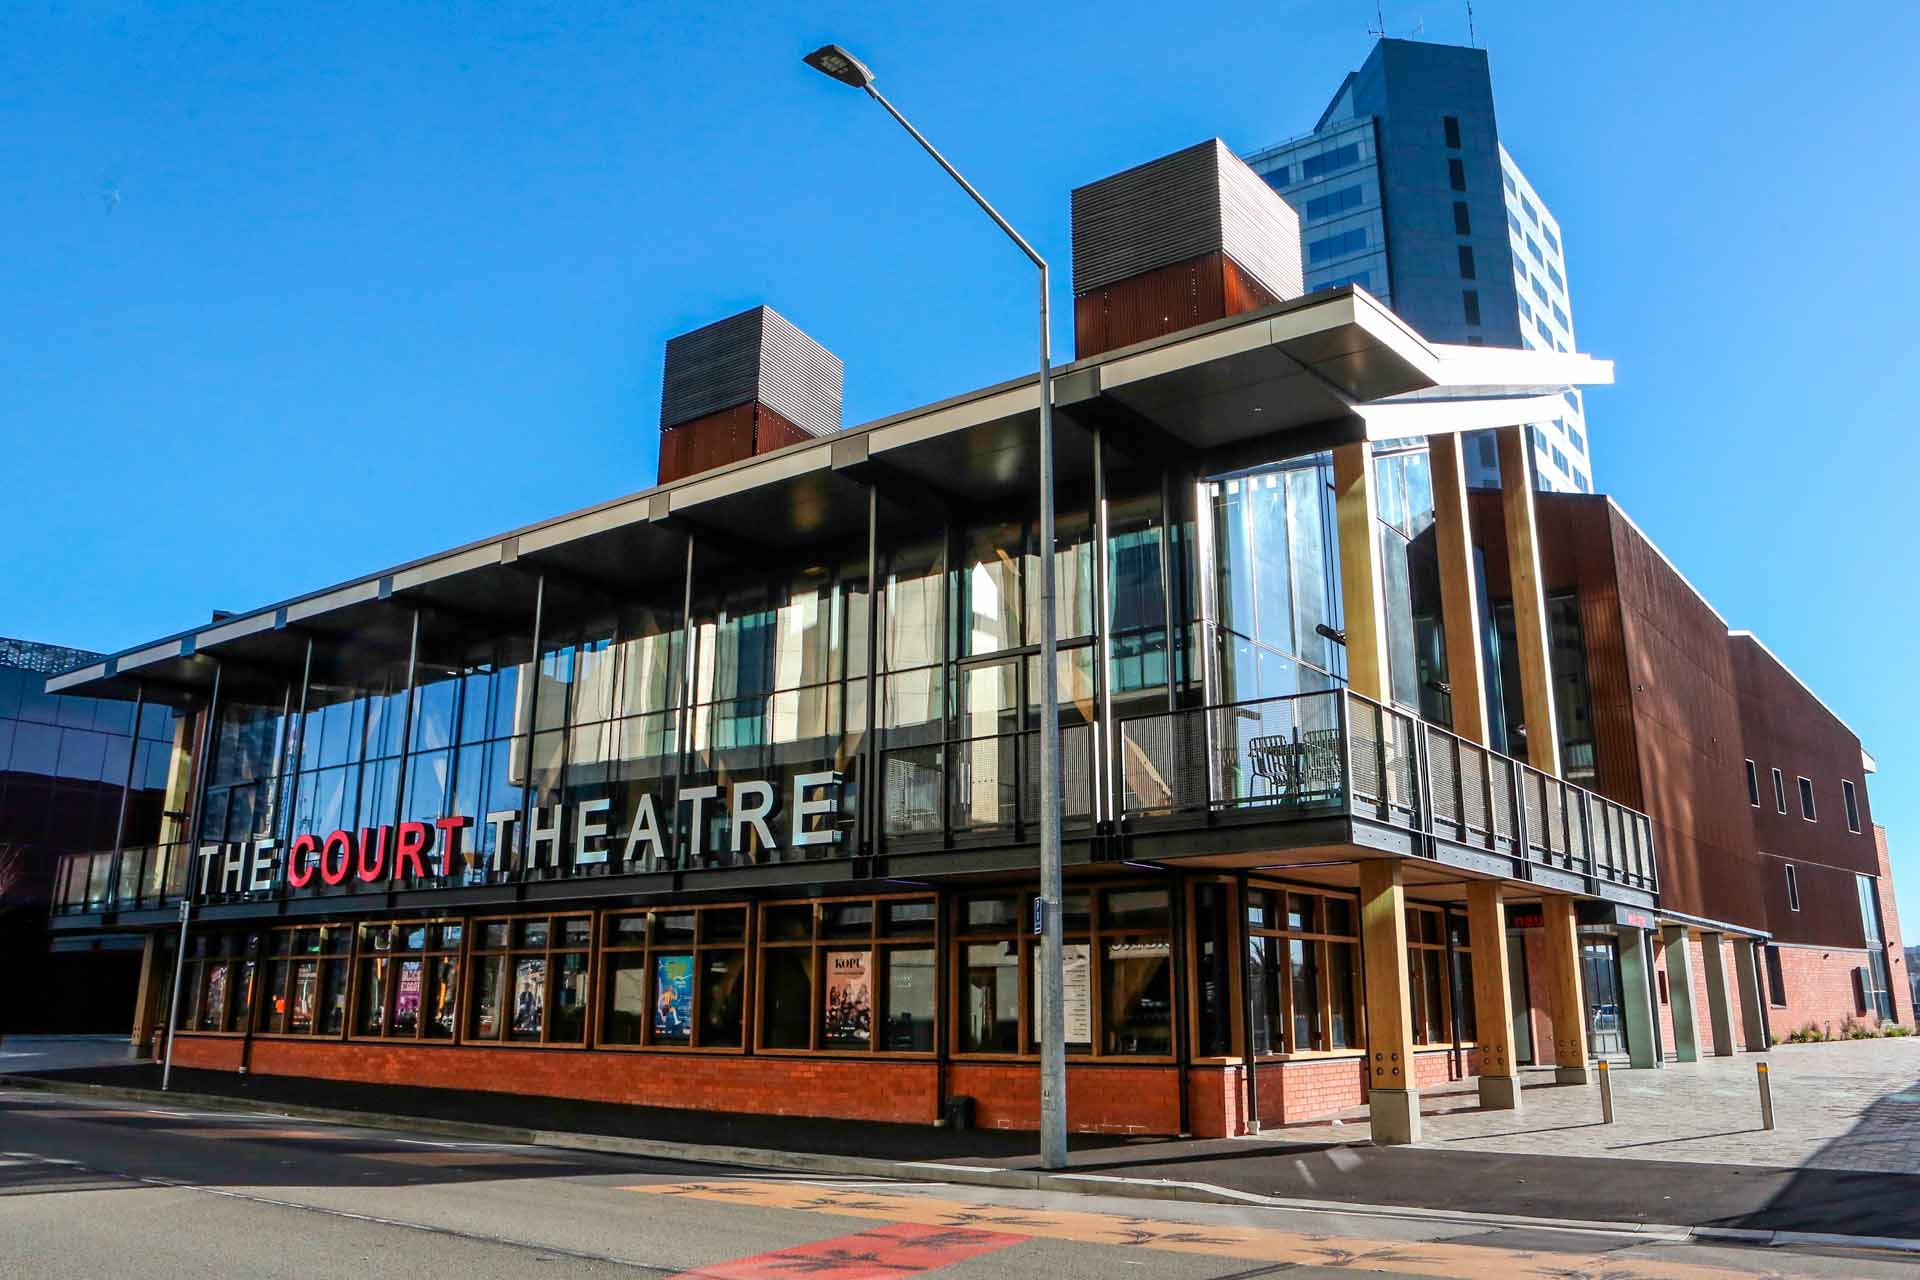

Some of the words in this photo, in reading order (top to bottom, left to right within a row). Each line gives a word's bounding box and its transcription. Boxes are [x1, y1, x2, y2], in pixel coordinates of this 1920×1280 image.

[200, 838, 276, 895] THE
[289, 816, 470, 888] COURT
[486, 771, 843, 873] THEATRE
